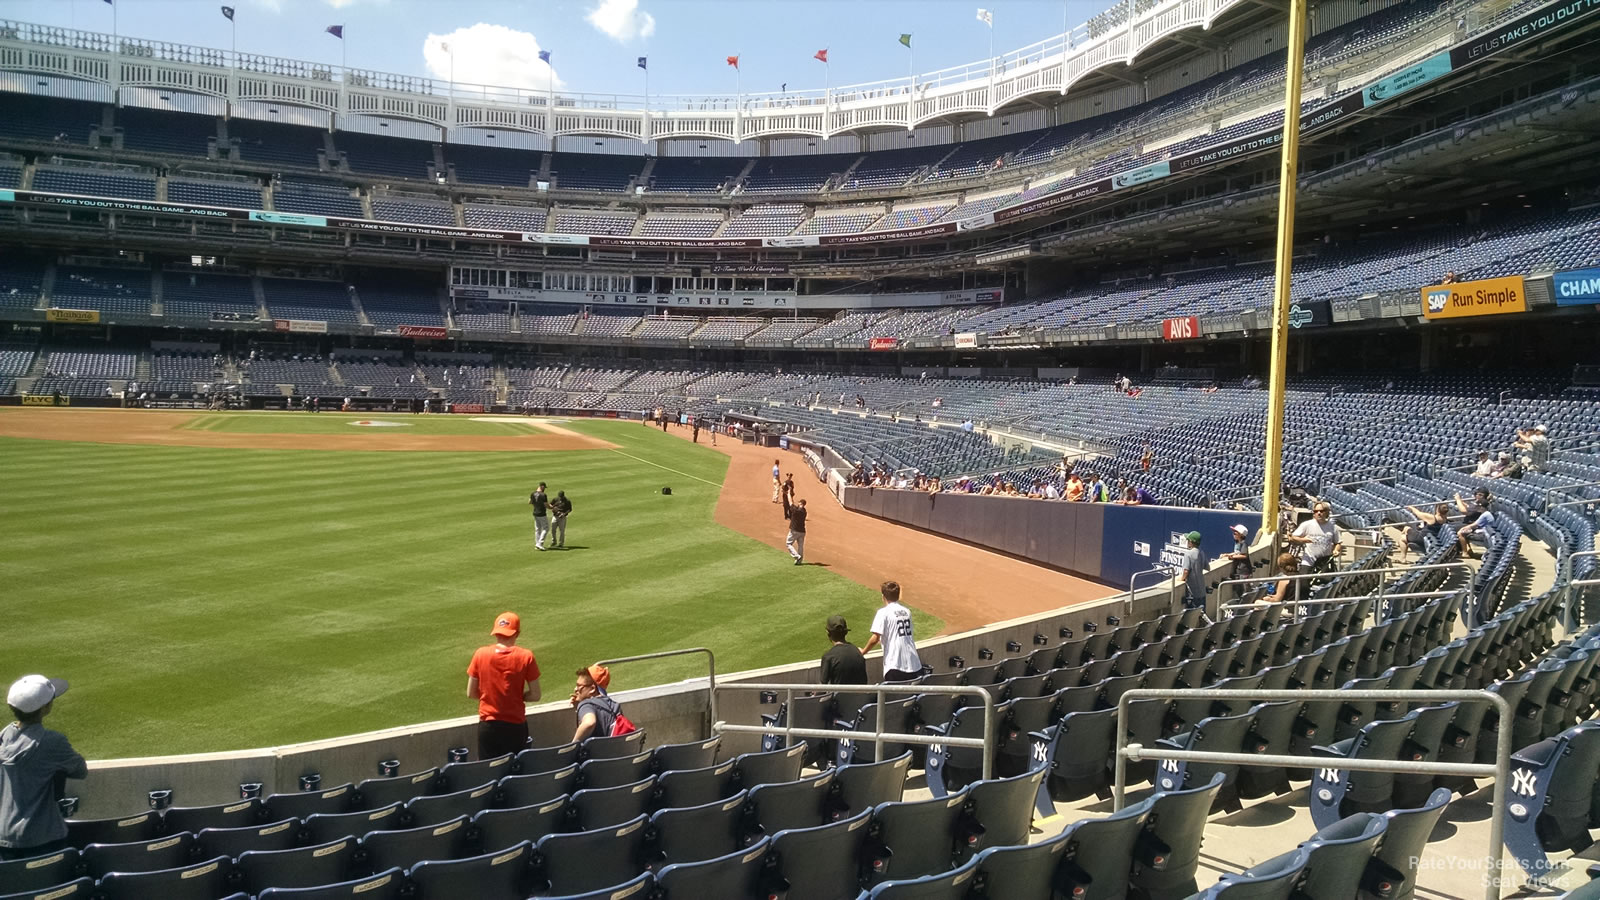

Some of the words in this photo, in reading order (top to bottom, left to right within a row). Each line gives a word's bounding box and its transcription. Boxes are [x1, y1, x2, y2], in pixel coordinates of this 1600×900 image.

[1468, 43, 1484, 59] LET
[1485, 38, 1499, 50] US
[1499, 24, 1529, 44] TAKE
[1530, 13, 1554, 31] YOU
[1557, 1, 1582, 20] OUT
[1180, 159, 1190, 168] LET
[1191, 158, 1199, 166] US
[1199, 153, 1217, 162] TAKE
[1217, 148, 1232, 157] YOU
[1232, 144, 1247, 153] OUT
[1247, 140, 1258, 149] TO
[1259, 136, 1273, 146] THE
[1273, 133, 1284, 142] BA
[1325, 106, 1344, 120] BACK
[1086, 187, 1099, 196] BACK
[755, 265, 784, 273] Champions
[1561, 278, 1600, 296] CHAM
[1428, 294, 1446, 309] SAP
[1452, 293, 1473, 307] Run
[1476, 288, 1516, 307] Simple
[401, 327, 445, 337] Budweiser
[1171, 318, 1191, 338] AVIS
[897, 619, 912, 637] 22
[1034, 741, 1047, 761] NY
[1511, 767, 1537, 797] NY
